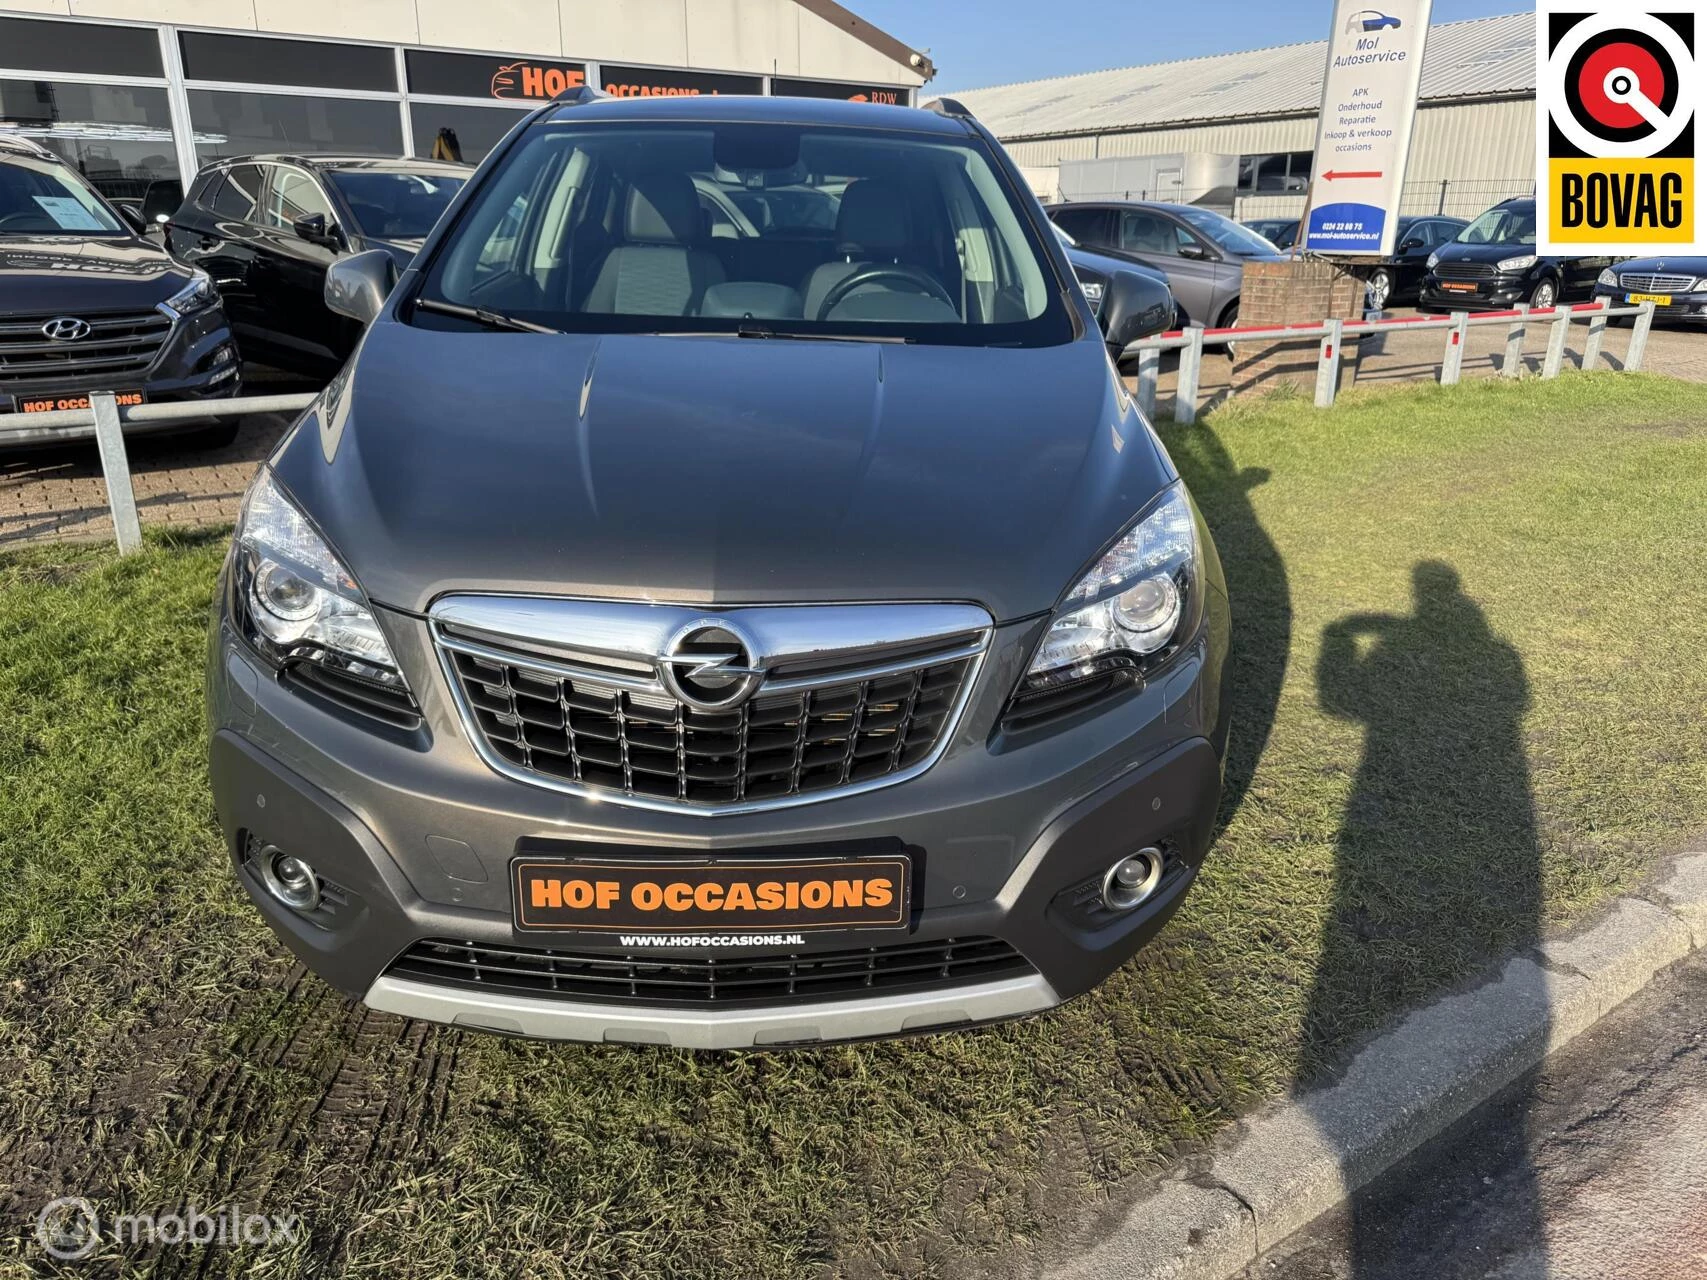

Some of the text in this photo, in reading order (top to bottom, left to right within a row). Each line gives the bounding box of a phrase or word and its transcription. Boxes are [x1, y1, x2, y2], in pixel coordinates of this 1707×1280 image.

[1355, 37, 1380, 51] Mol
[1333, 50, 1406, 68] Autoservice
[1352, 88, 1369, 97] APK
[1337, 100, 1383, 112] Onderhoud
[1338, 115, 1377, 126] Reparatie
[1324, 129, 1392, 140] Inkoop & verkoop
[1335, 142, 1372, 152] occasions
[23, 400, 55, 413] HOF
[530, 878, 893, 911] HOF OCCASIONS
[620, 935, 805, 947] WWW.HOFOCCASIONS.NL
